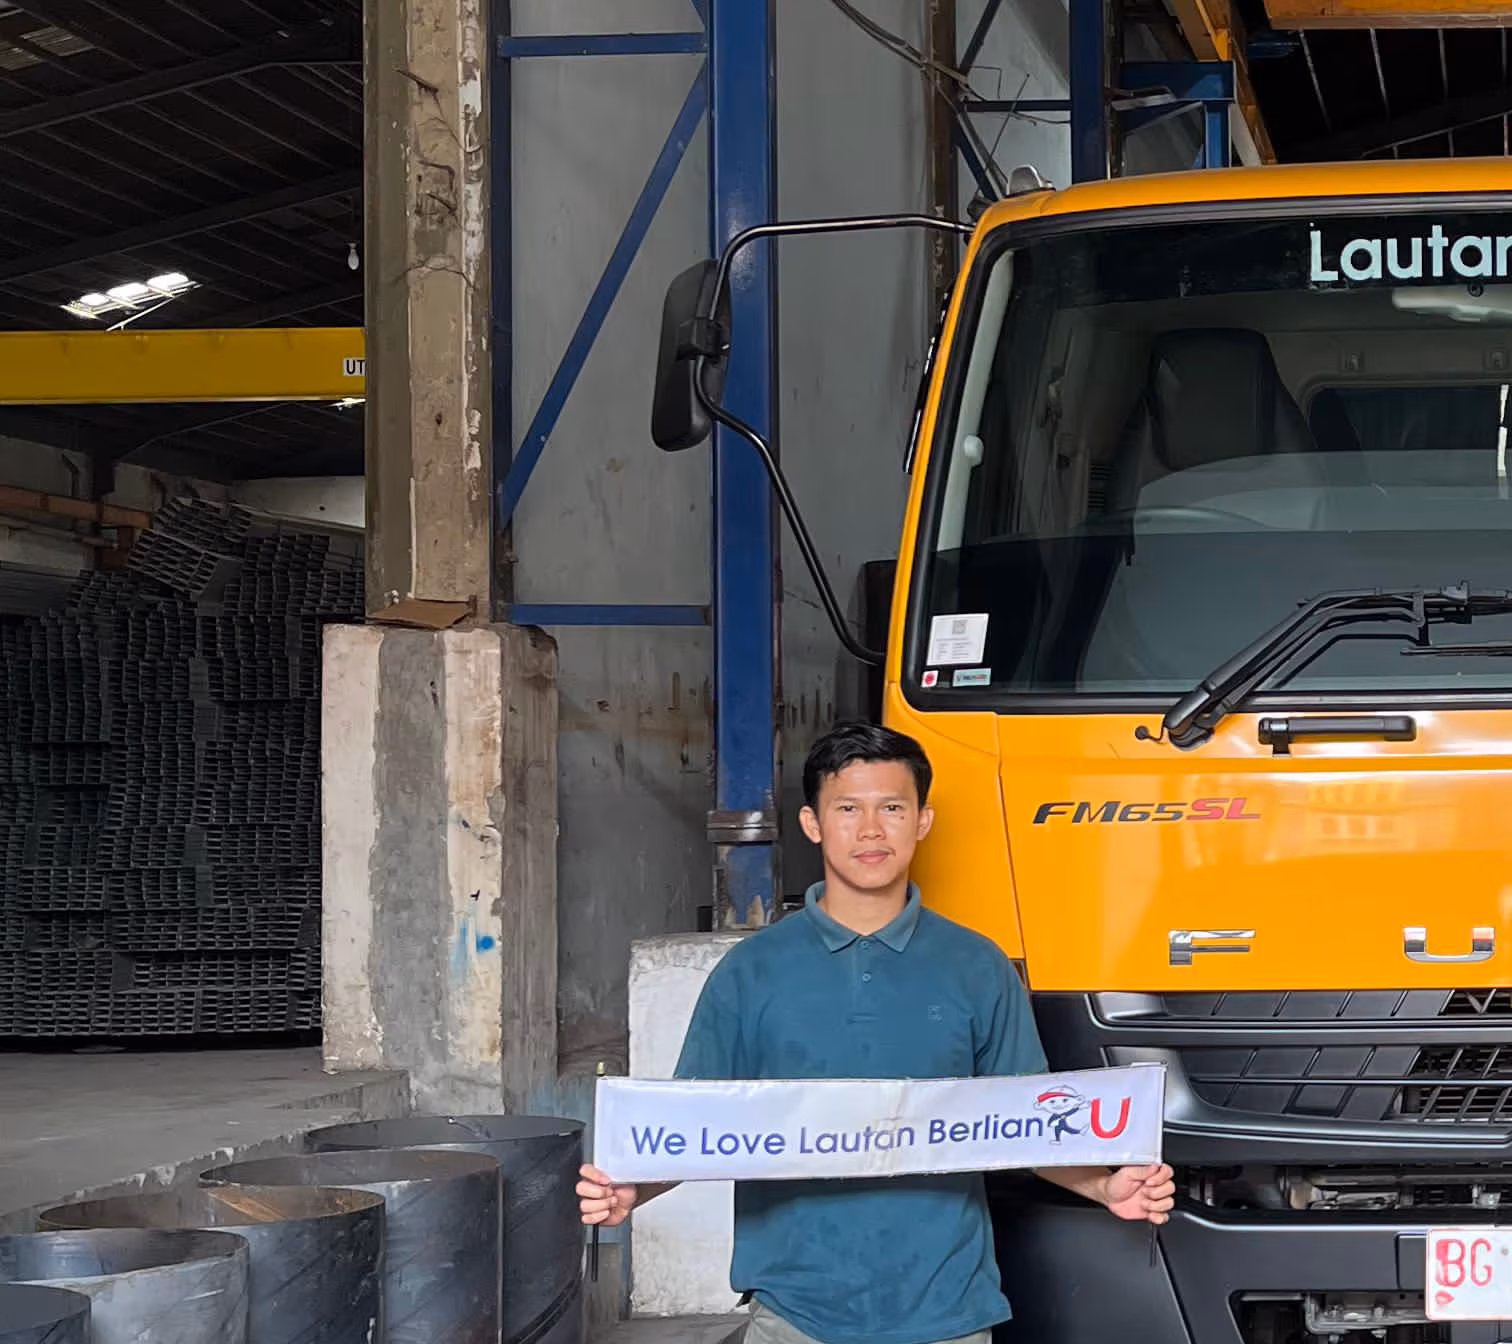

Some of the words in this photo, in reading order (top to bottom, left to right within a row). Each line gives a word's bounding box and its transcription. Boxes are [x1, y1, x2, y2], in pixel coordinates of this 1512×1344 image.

[1032, 797, 1261, 824] FM65SL
[631, 1124, 687, 1156] We
[700, 1126, 786, 1156] Love
[800, 1123, 915, 1155] Lautan
[1435, 1238, 1493, 1288] BG
